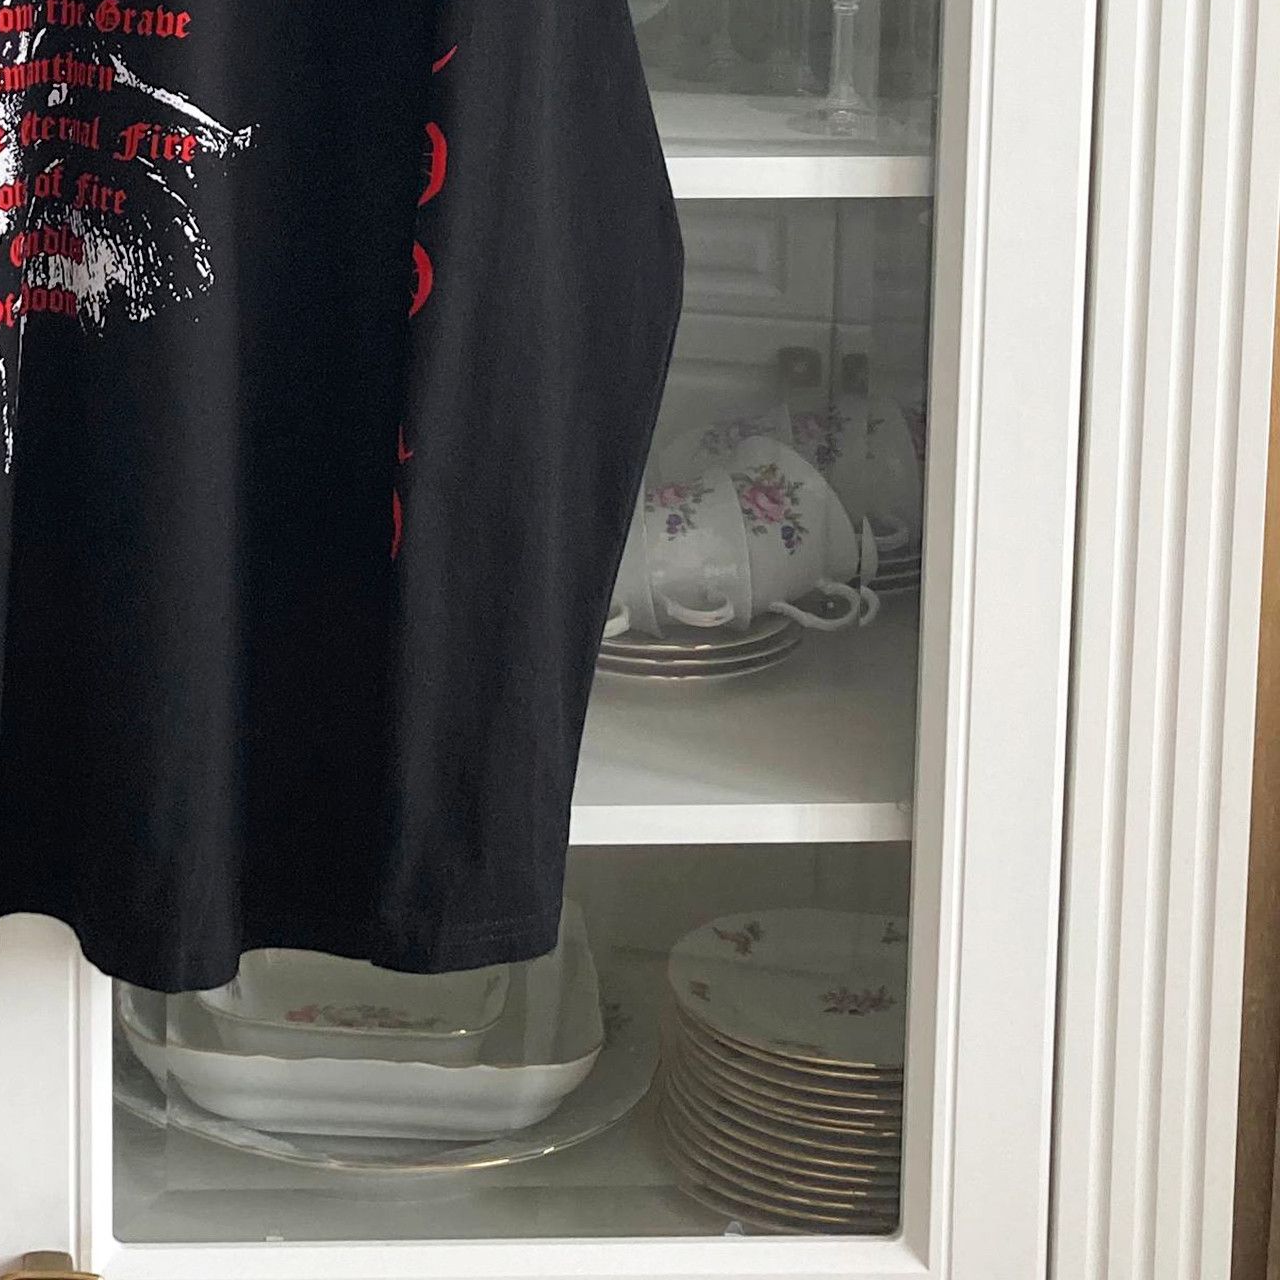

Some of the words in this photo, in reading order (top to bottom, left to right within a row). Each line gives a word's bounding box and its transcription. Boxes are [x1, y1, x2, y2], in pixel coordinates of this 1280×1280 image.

[96, 0, 191, 39] Grave
[113, 122, 197, 162] Fire
[34, 165, 62, 198] of
